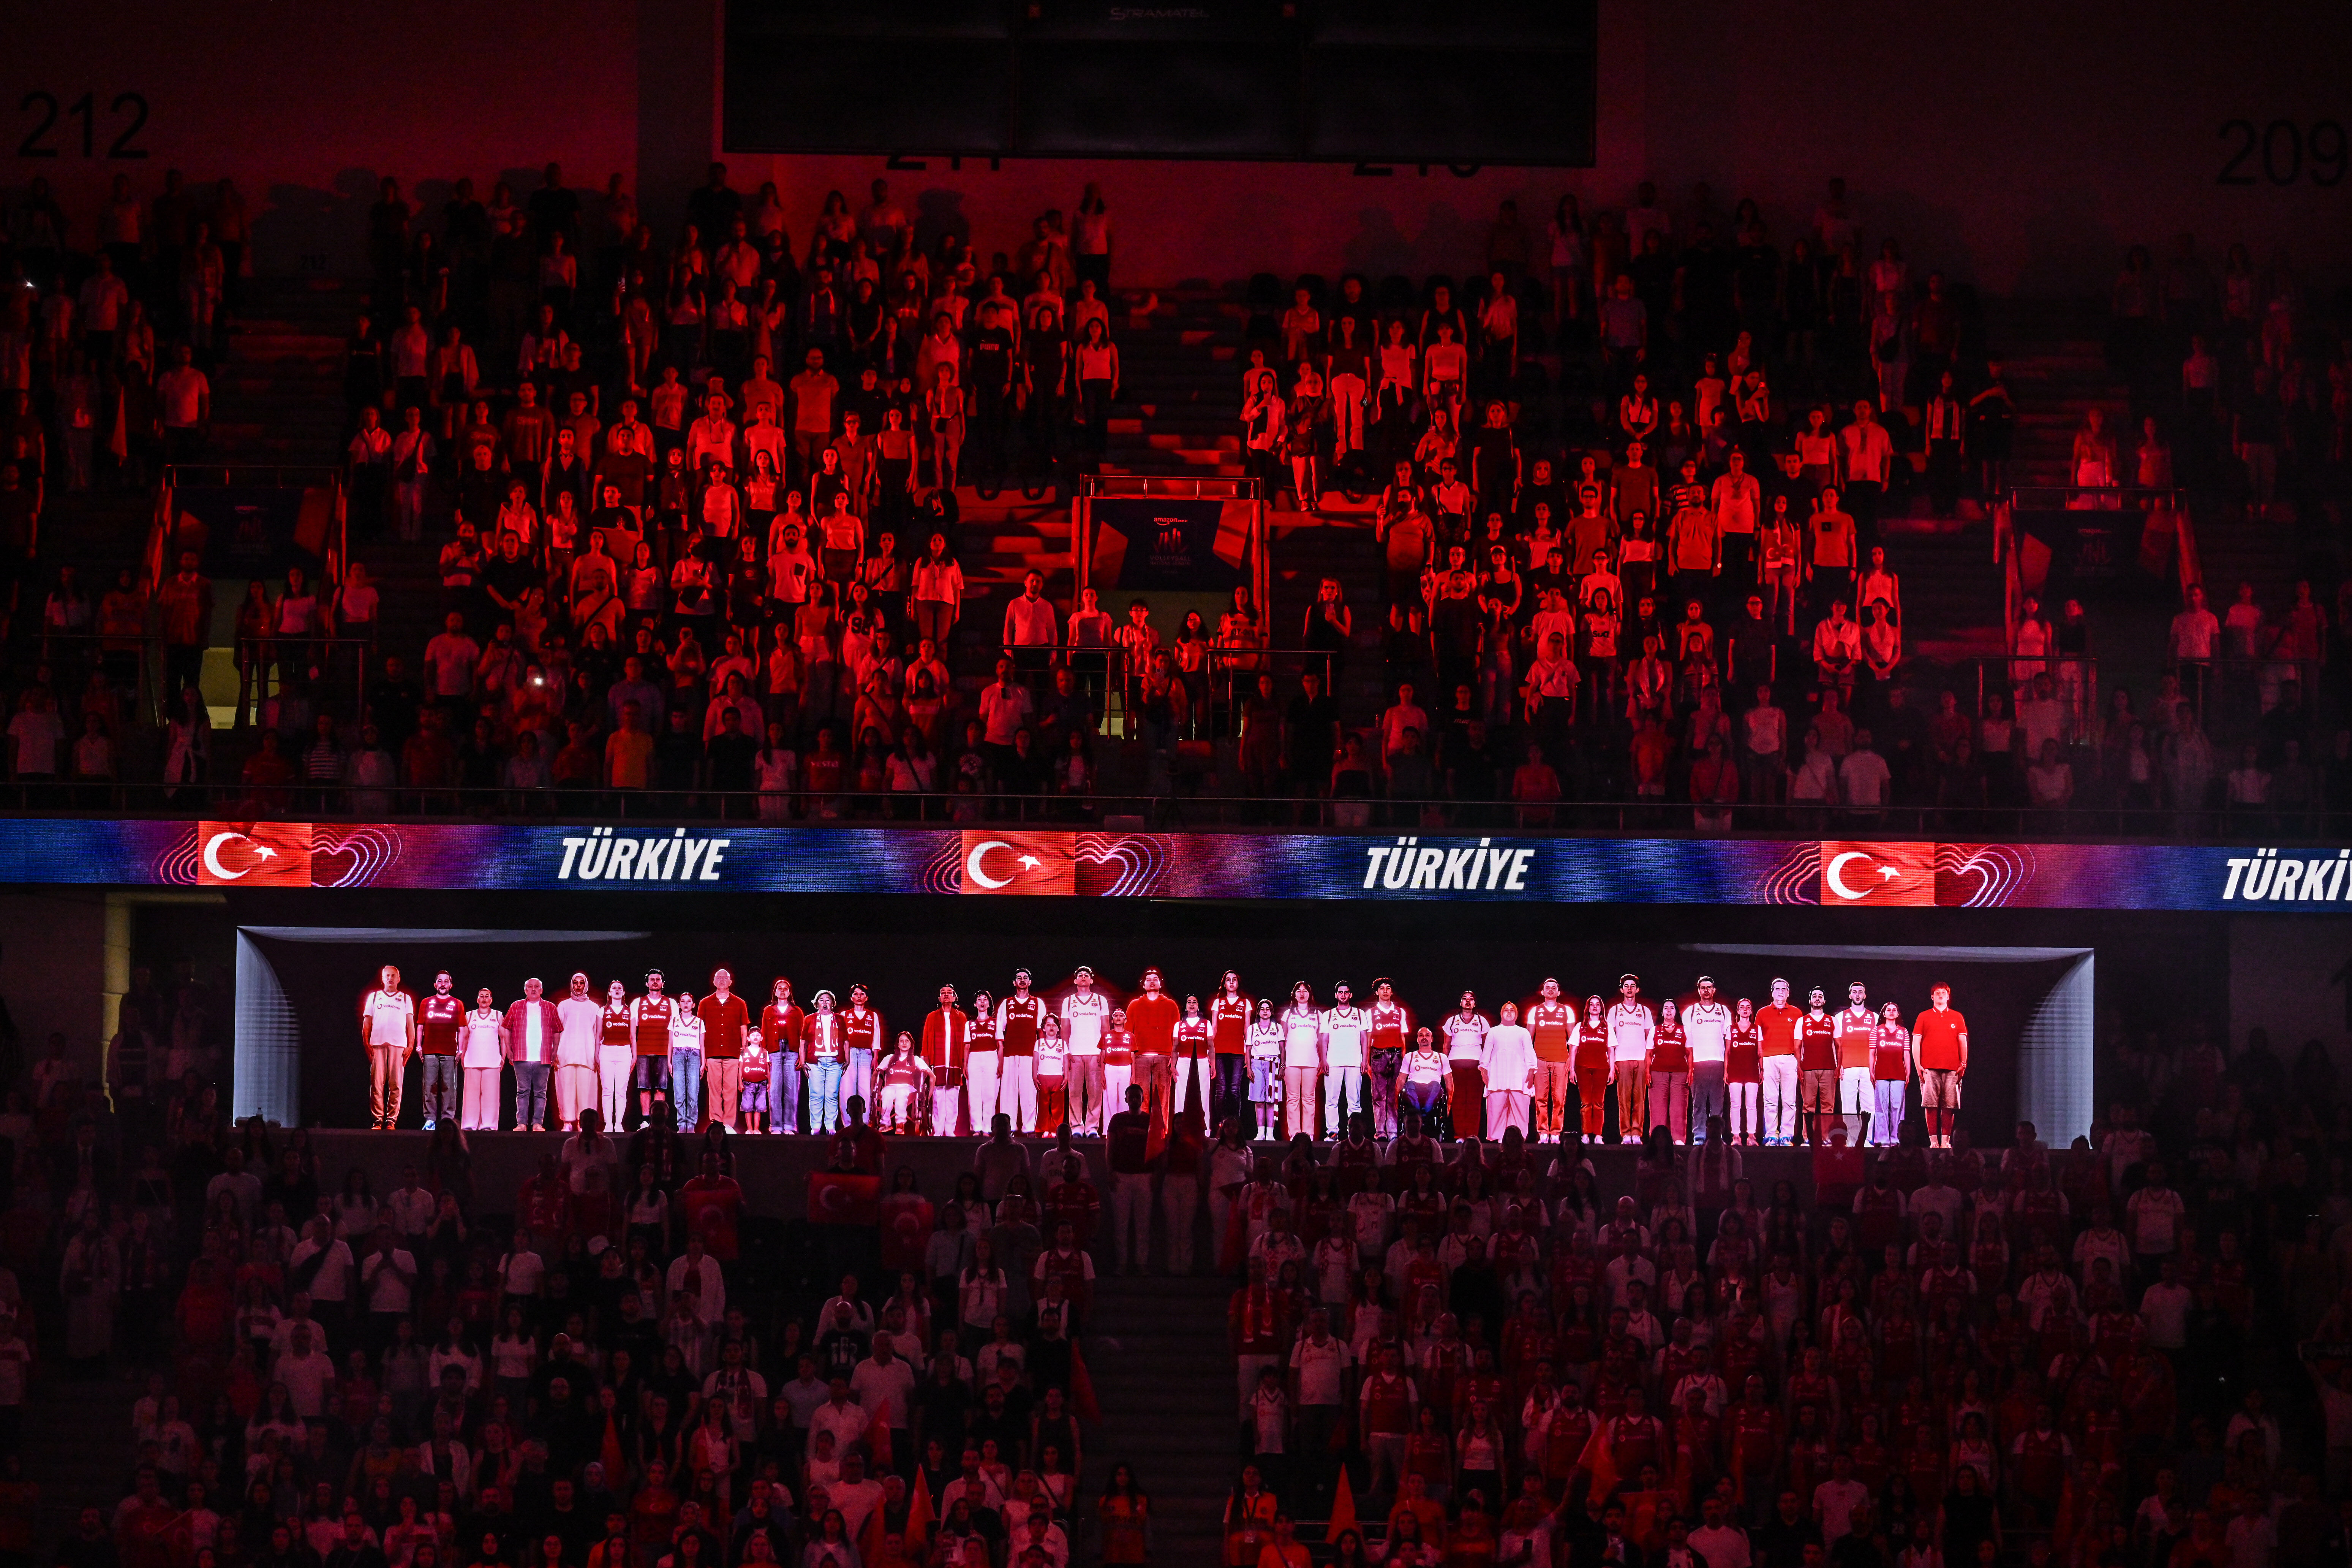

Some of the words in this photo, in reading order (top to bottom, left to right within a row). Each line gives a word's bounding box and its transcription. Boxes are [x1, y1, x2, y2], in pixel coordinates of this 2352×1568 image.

[1110, 8, 1209, 19] STRAMATEL
[19, 91, 148, 157] 212
[2217, 120, 2348, 186] 209
[558, 827, 730, 880] TÜRKİYE
[1363, 837, 1535, 890] TÜRKİYE
[2222, 848, 2352, 901] TÜRKİ
